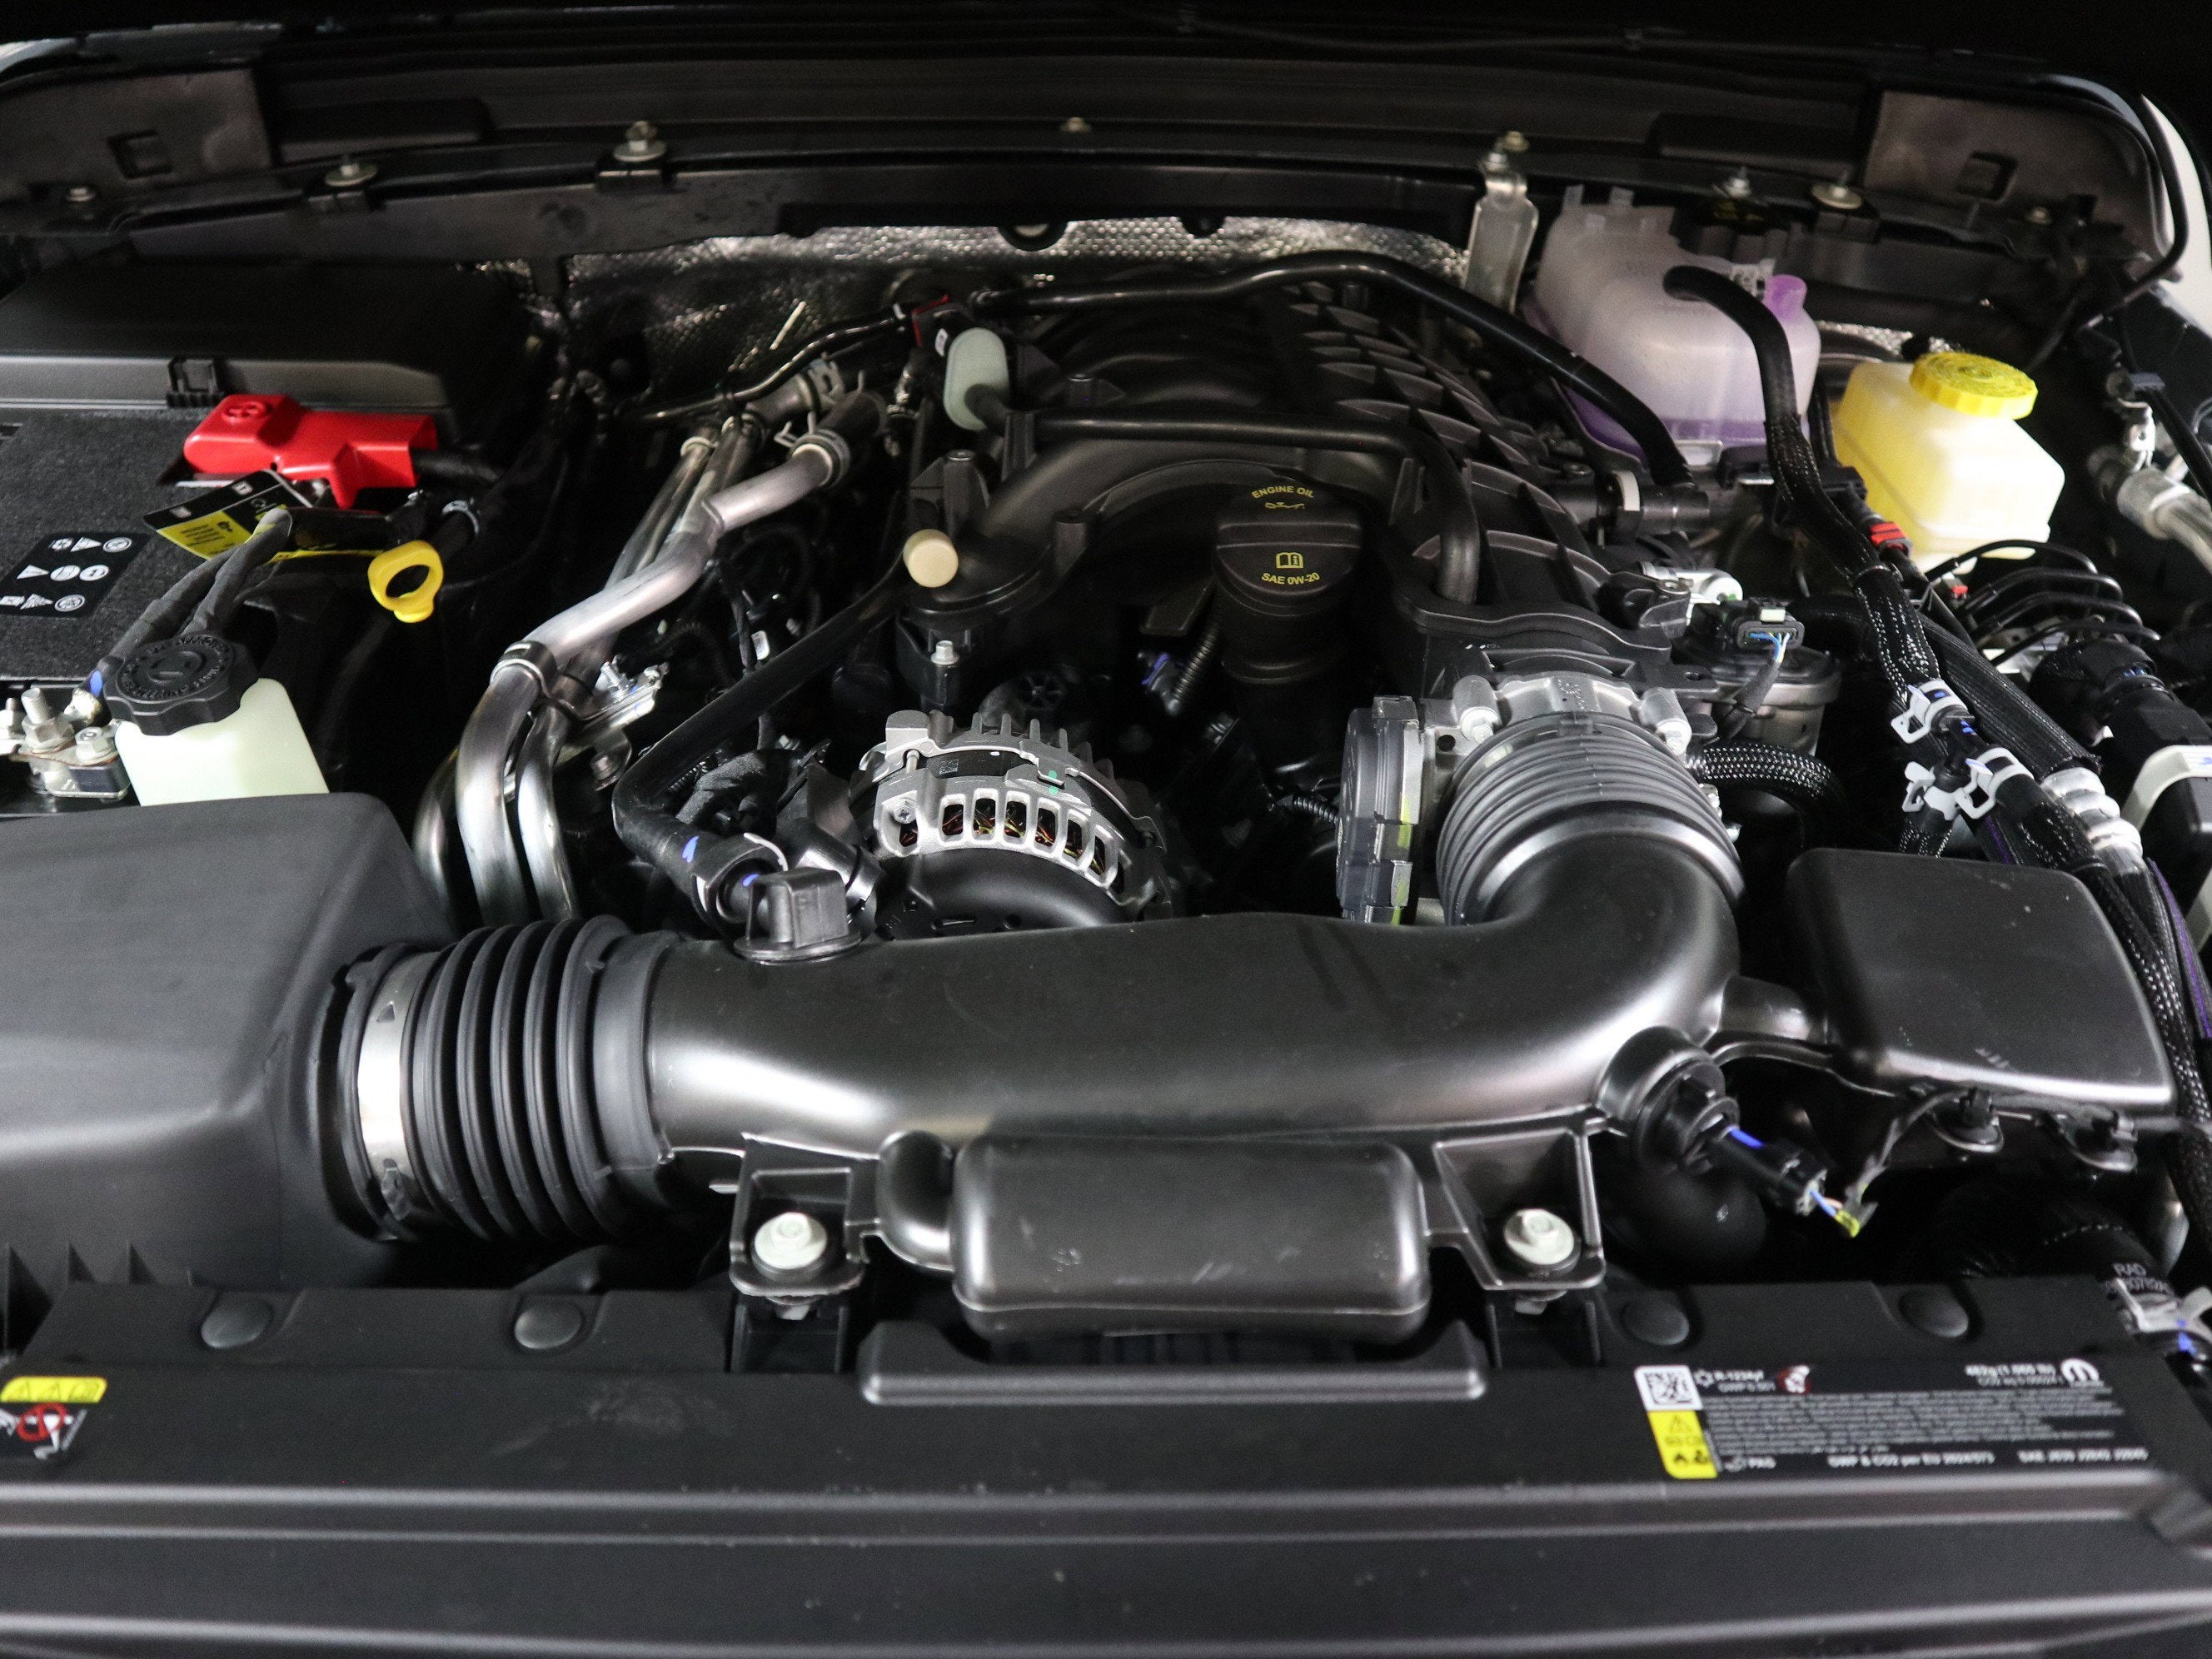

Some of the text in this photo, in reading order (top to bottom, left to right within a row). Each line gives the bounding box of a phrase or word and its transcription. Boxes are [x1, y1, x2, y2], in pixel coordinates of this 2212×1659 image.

[1251, 486, 1314, 498] ENGINE OIL
[1261, 572, 1320, 585] SAE 0W-20
